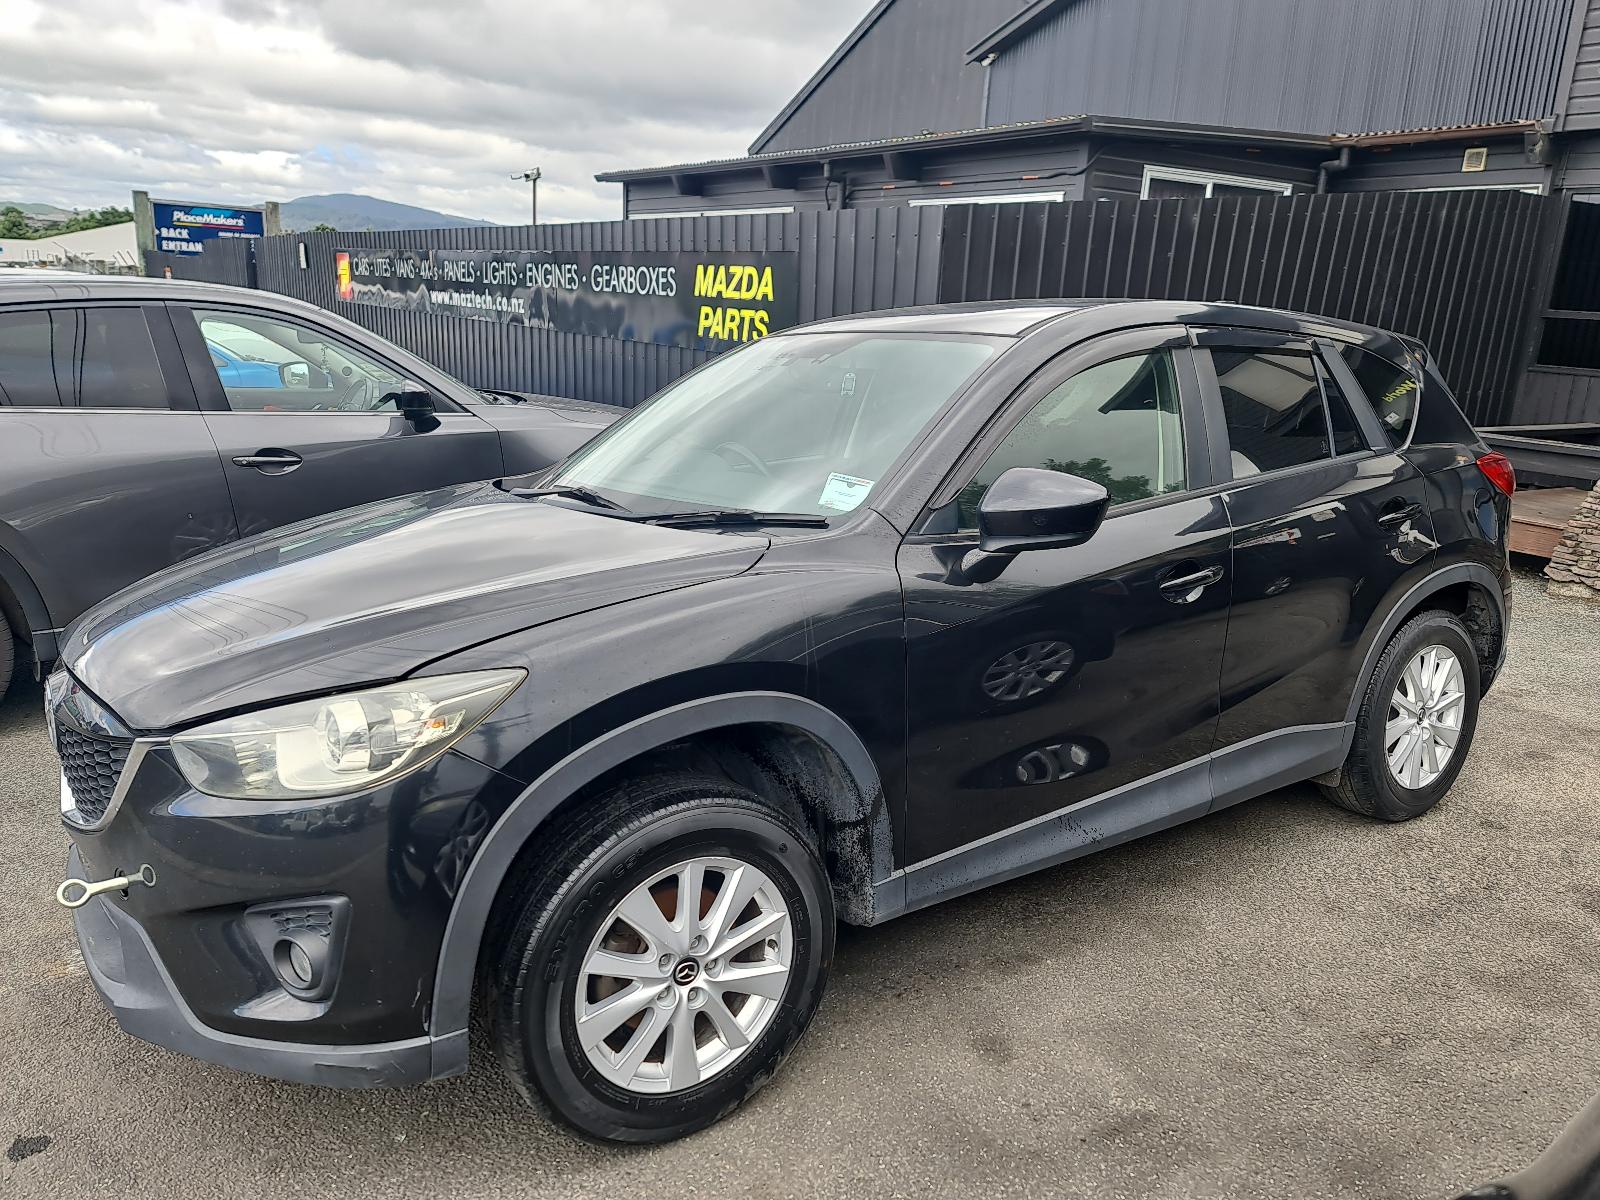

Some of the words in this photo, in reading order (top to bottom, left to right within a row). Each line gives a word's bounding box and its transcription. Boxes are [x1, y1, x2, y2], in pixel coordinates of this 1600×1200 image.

[172, 211, 245, 226] PlaceMakers
[160, 227, 190, 239] BACK
[161, 239, 204, 253] ENTRAN
[353, 257, 370, 276] CARS
[374, 258, 391, 278] UTES
[394, 258, 415, 279] VANS
[443, 260, 475, 283] PANELS
[482, 261, 518, 286] LIGHTS
[525, 263, 579, 290] ENGINES
[590, 264, 677, 297] GEARBOXES
[693, 264, 774, 302] MAZDA
[430, 288, 525, 314] www.maztech.co.nz
[697, 305, 769, 342] PARTS
